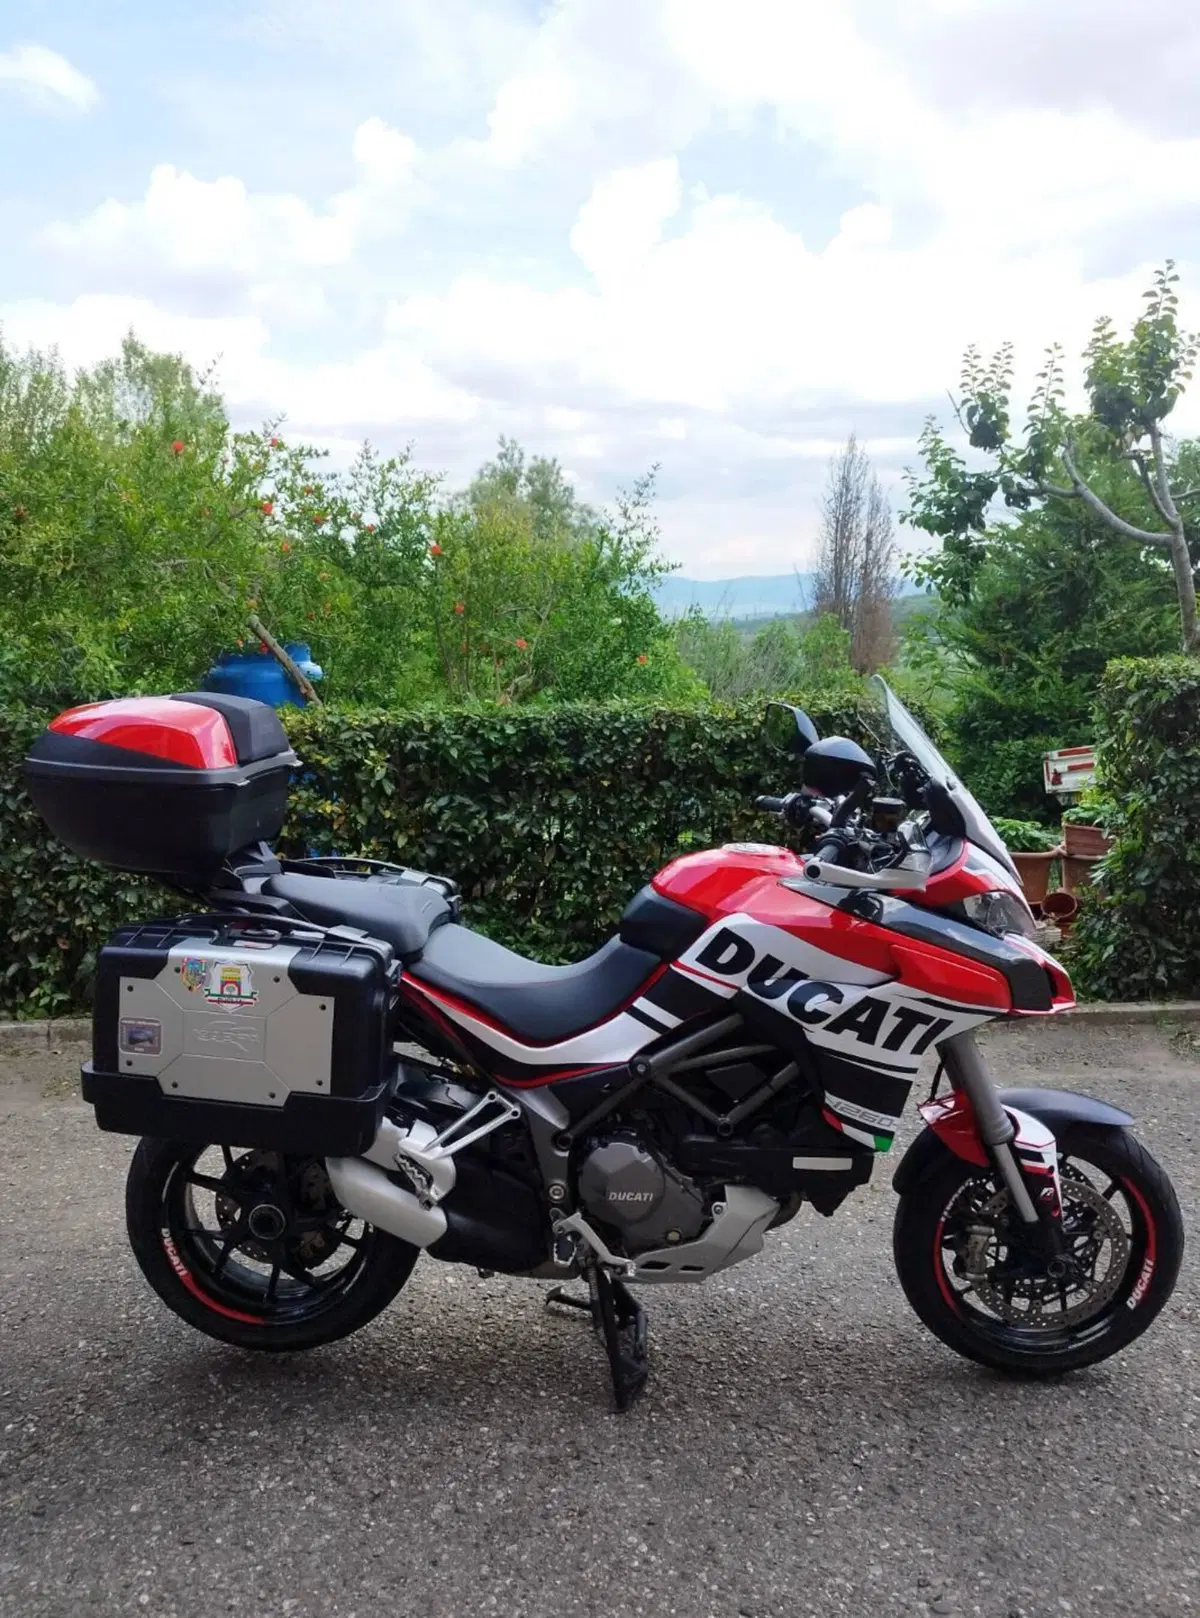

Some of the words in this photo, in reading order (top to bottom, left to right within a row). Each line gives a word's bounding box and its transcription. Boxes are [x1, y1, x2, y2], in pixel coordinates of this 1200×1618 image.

[695, 927, 953, 1055] DUCATI
[608, 1191, 654, 1202] DUCATI
[161, 1227, 188, 1277] DUCATI
[1126, 1258, 1154, 1310] DUCATI
